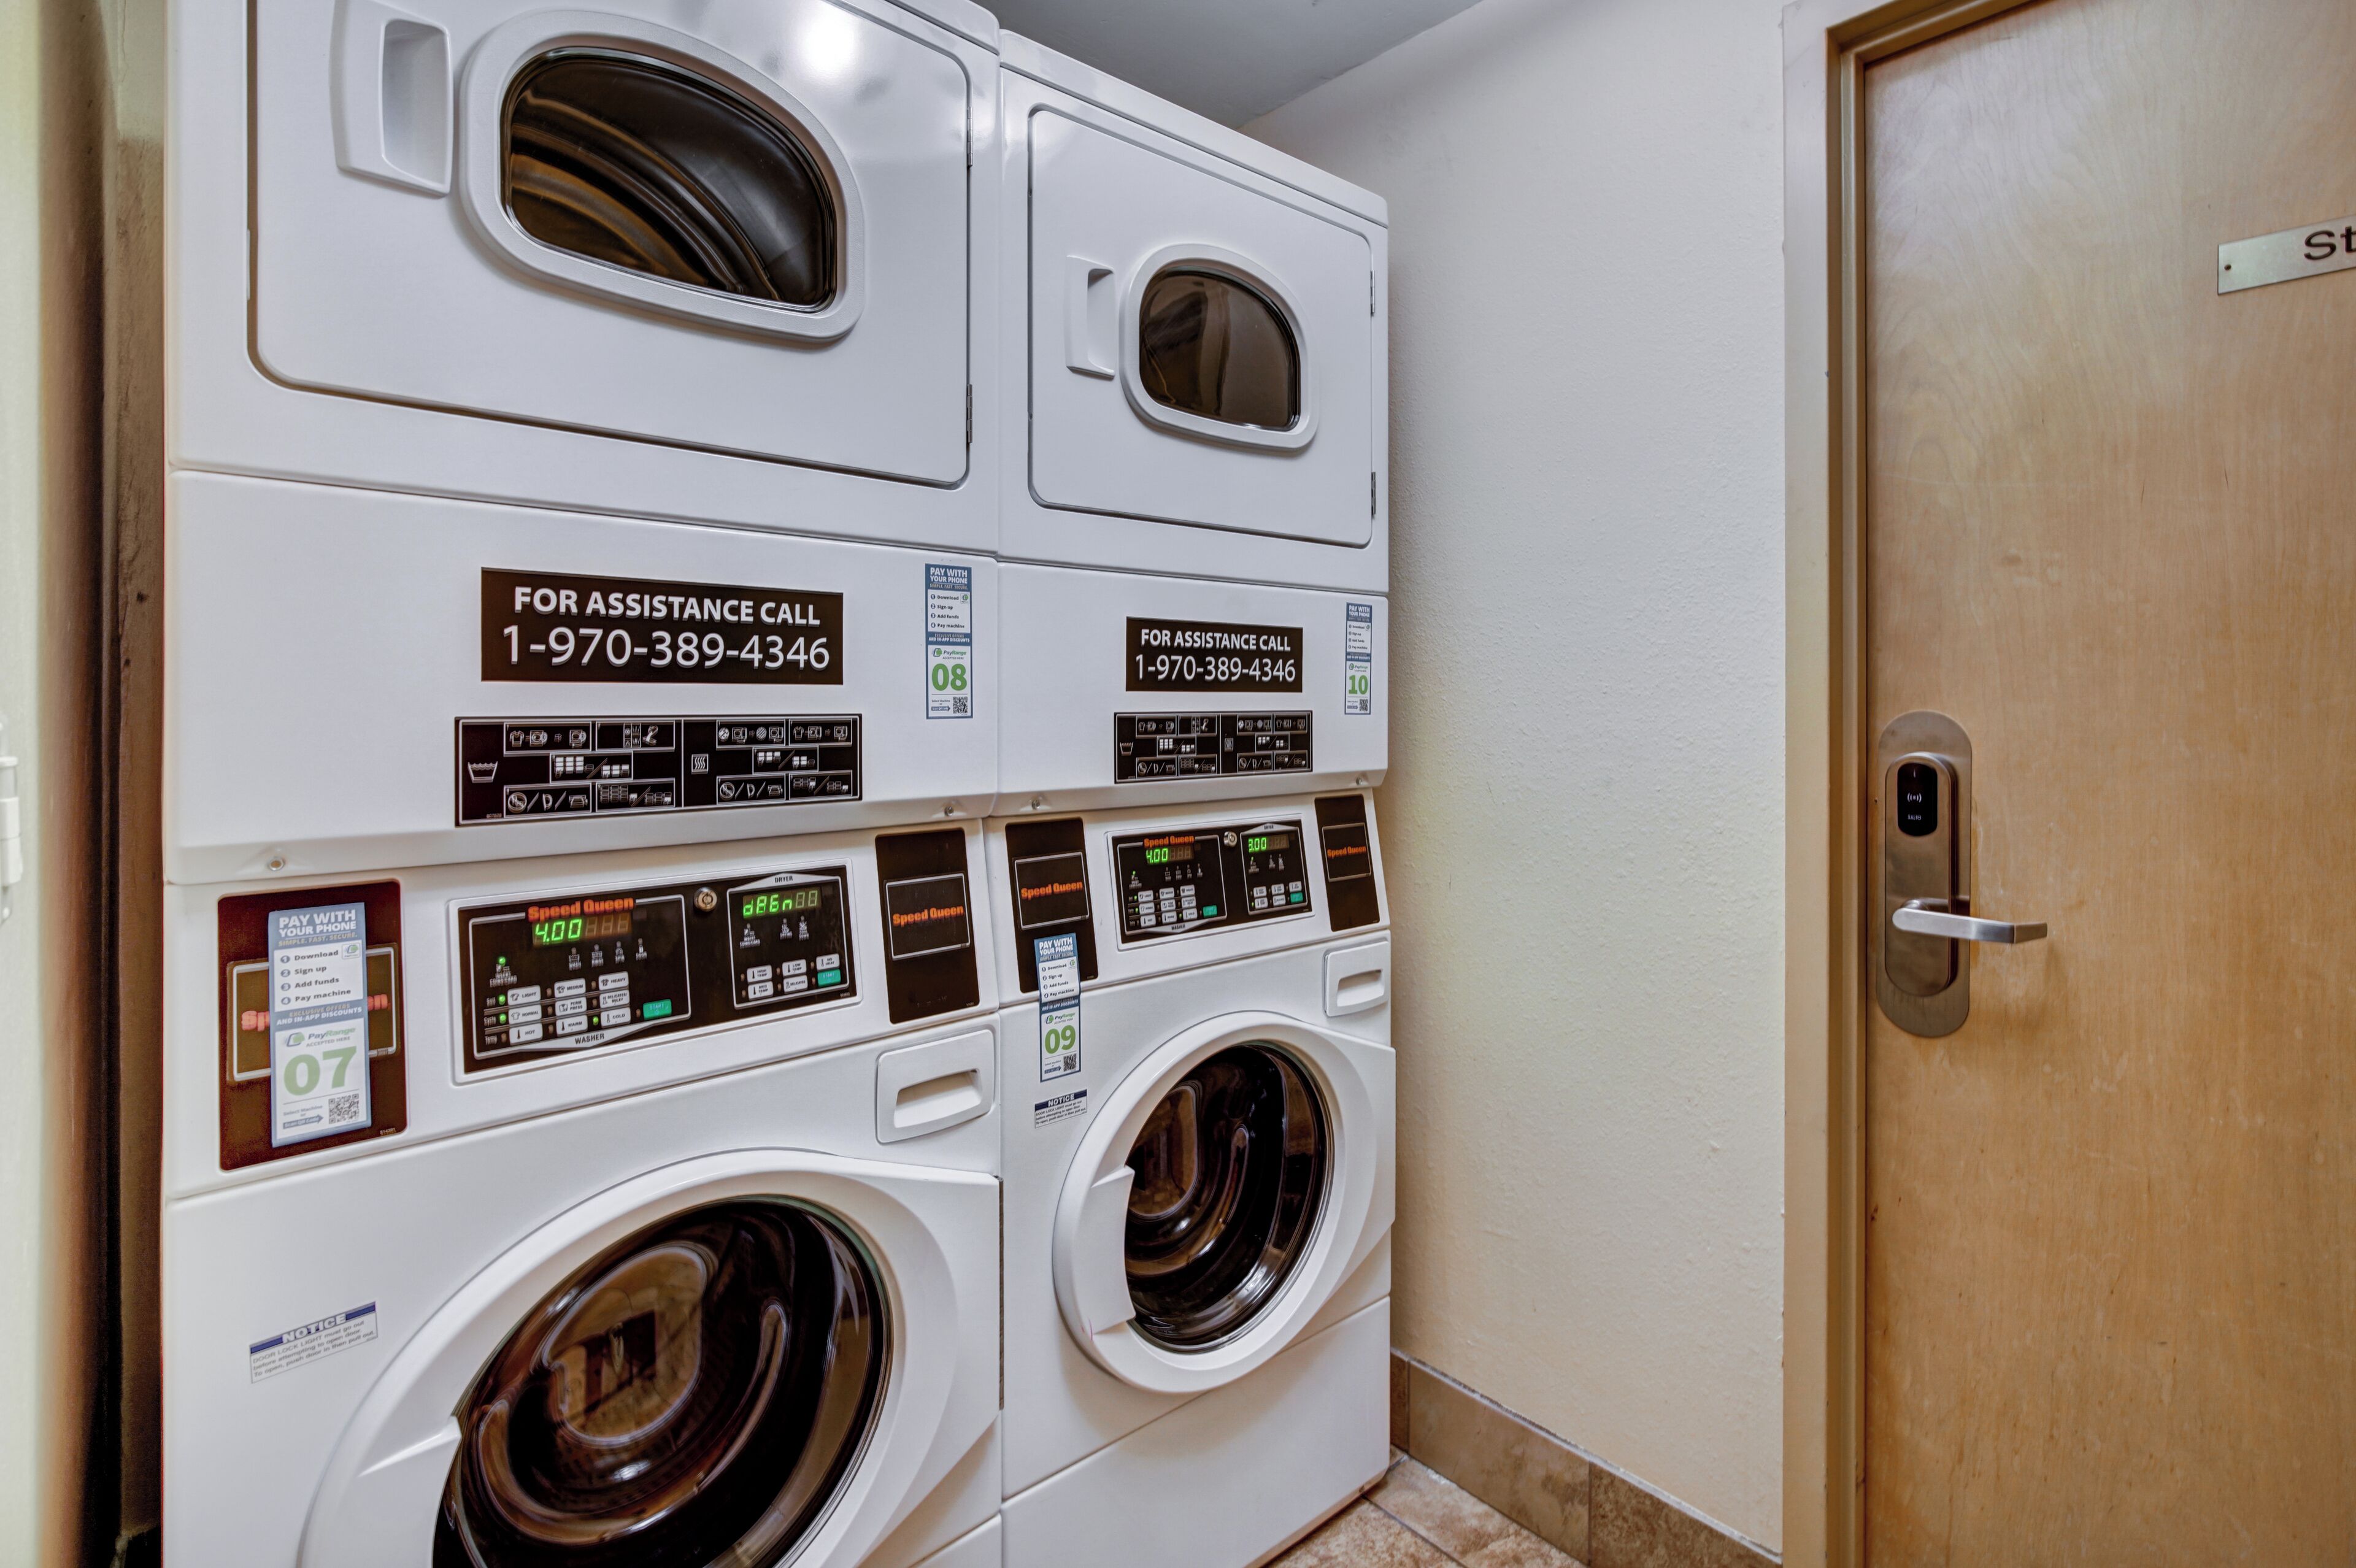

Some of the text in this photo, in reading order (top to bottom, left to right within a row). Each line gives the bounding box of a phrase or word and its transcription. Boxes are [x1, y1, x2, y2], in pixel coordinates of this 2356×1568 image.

[930, 567, 968, 577] PAY WITH
[514, 586, 821, 627] FOR ASSISTANCE CALL
[503, 624, 830, 671] 1-970-389-4346
[1141, 629, 1291, 651] FOR ASSISTANCE CALL
[932, 663, 967, 691] 08
[1136, 654, 1296, 682] 1-970-389-4346
[1349, 675, 1368, 694] 10
[1144, 836, 1169, 848] Speed
[1146, 848, 1168, 863] 4.00
[1327, 845, 1366, 858] Speed Queen
[1021, 882, 1083, 901] Speed Queen
[279, 910, 356, 928] PAY WITH
[528, 897, 634, 923] Speed Queen
[893, 905, 964, 927] Speed Queen
[279, 921, 356, 937] YOUR PHONE
[329, 932, 358, 942] SECURE.
[535, 918, 582, 943] 4.00
[1039, 937, 1072, 950] PAY WITH
[1040, 944, 1073, 956] YOUR PHONE
[294, 950, 339, 961] Download
[315, 977, 339, 986] funds
[314, 988, 351, 999] machine
[277, 1017, 292, 1026] AND
[294, 1013, 320, 1023] IN-APP
[321, 1007, 363, 1019] DISCOUNTS
[289, 1003, 350, 1017] EXCLUSIVE OFFERS
[308, 1028, 356, 1040] PayRange
[575, 1033, 604, 1044] WASHER
[1045, 1025, 1076, 1054] 09
[306, 1039, 335, 1048] ACCEPTED
[284, 1046, 357, 1096] 07
[1048, 1094, 1074, 1107] NOTICE
[282, 1313, 346, 1343] NOTICE
[253, 1352, 275, 1363] DOOR
[278, 1344, 298, 1355] LOCK
[301, 1334, 322, 1346] LIGHT
[325, 1329, 341, 1338] must
[253, 1359, 276, 1370] before
[279, 1345, 315, 1362] attempting
[326, 1335, 343, 1344] open
[286, 1356, 304, 1366] push
[306, 1350, 321, 1358] door
[332, 1340, 347, 1349] then
[348, 1335, 361, 1343] pull
